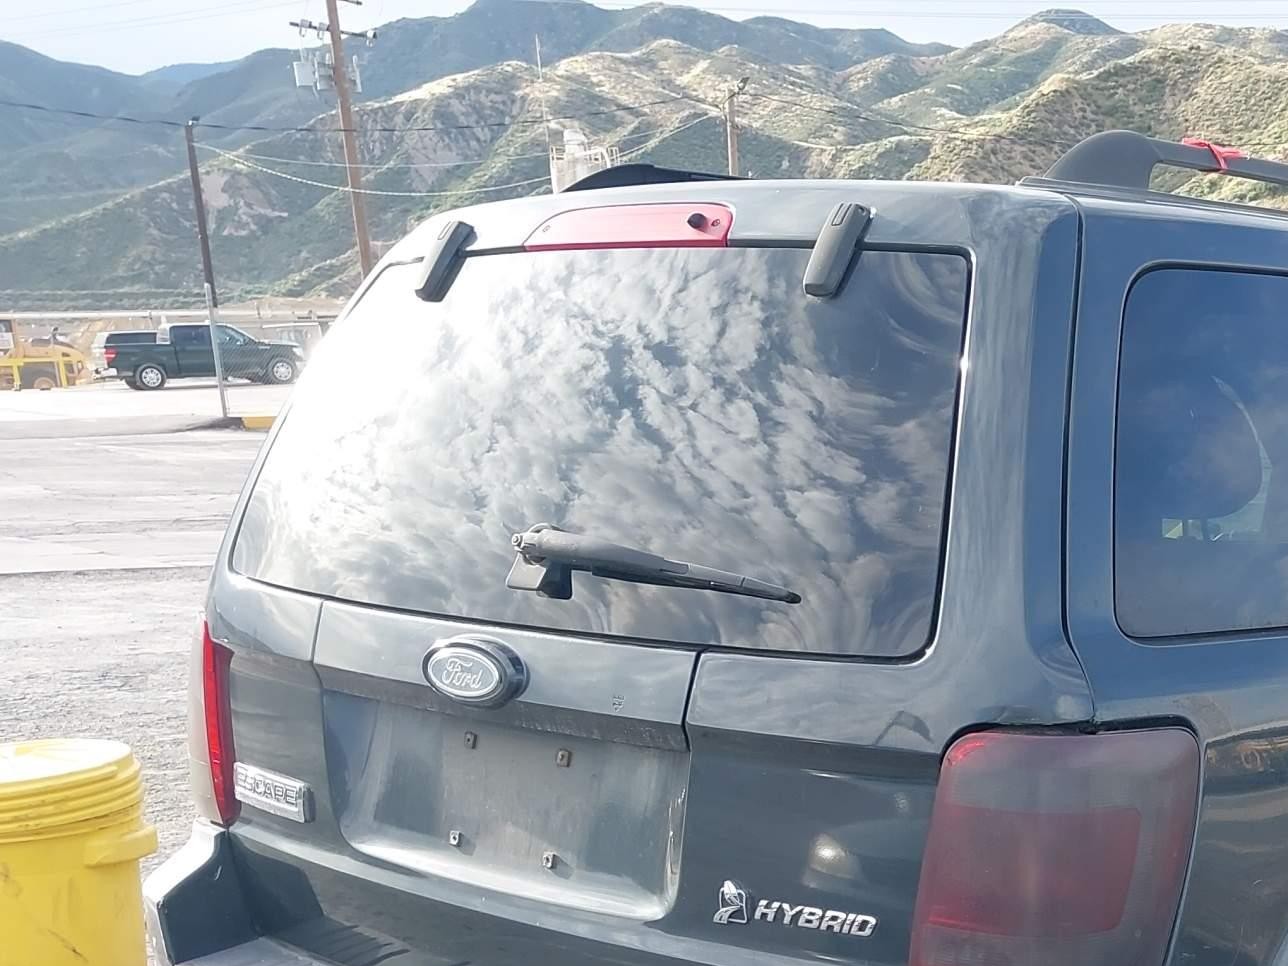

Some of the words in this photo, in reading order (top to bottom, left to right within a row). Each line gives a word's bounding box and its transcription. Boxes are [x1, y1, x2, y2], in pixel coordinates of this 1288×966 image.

[442, 657, 484, 689] Ford
[237, 769, 298, 807] ESCAPE
[753, 899, 877, 937] HYBRID
